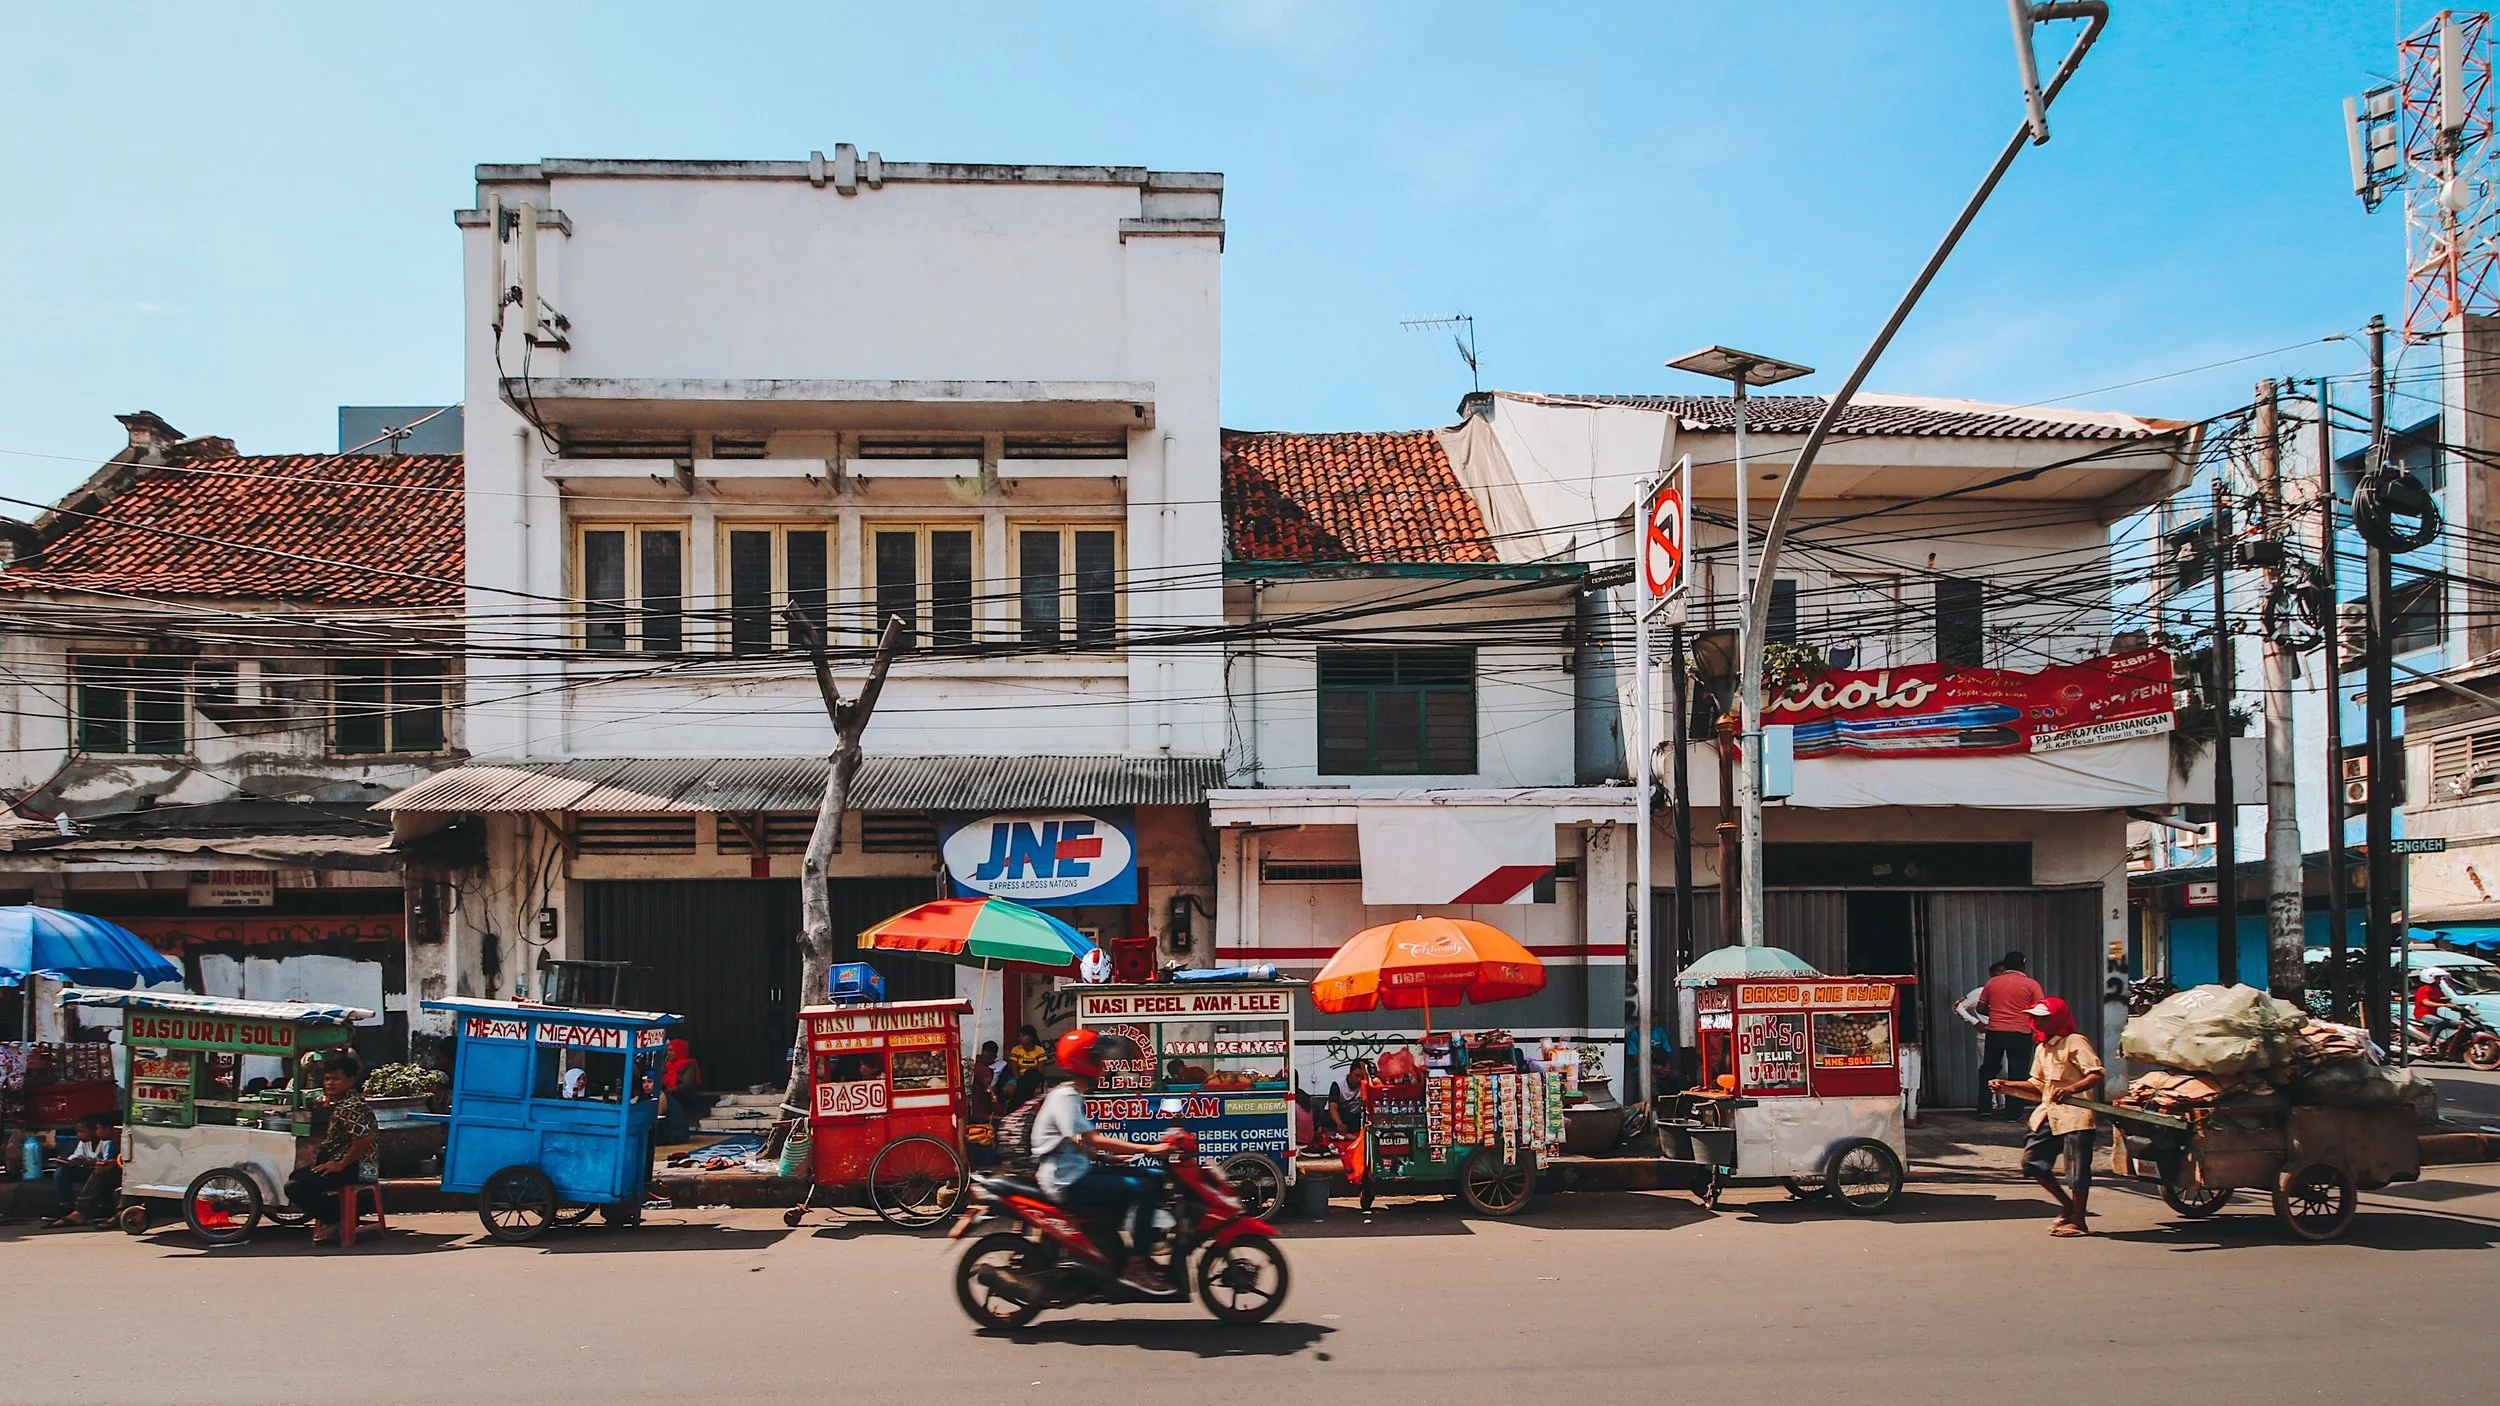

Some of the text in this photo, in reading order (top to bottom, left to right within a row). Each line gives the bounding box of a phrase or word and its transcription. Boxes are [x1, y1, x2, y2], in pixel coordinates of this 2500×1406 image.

[2131, 682, 2168, 703] PEN!
[2073, 738, 2095, 746] Besar
[2096, 733, 2121, 743] Timur
[2135, 728, 2150, 737] No.
[976, 820, 1102, 880] JNE
[989, 880, 1078, 890] EXPRESS ACROSS NATIONS
[1742, 985, 1799, 1003] BAKSO
[1814, 986, 1843, 1002] MIE
[1847, 985, 1890, 1001] AYAM
[1089, 998, 1128, 1013] NASI
[1134, 996, 1185, 1012] PECEL
[132, 1017, 292, 1047] BASO URAT SOLO
[1738, 1015, 1805, 1056] BAKSO
[1117, 1024, 1158, 1070] PECEL
[1214, 1040, 1288, 1054] PENYET
[1756, 1051, 1792, 1061] TELUR
[1748, 1062, 1800, 1082] URAT
[1098, 1075, 1152, 1089] LELE
[820, 1084, 885, 1112] BASO
[1227, 1102, 1287, 1111] PAKDE AREMA
[1085, 1099, 1152, 1120] PECEL
[1198, 1128, 1289, 1140] BEBEK GORENG
[1379, 1138, 1409, 1146] RASA LEBIH
[1198, 1141, 1286, 1153] BEBEK PENYET
